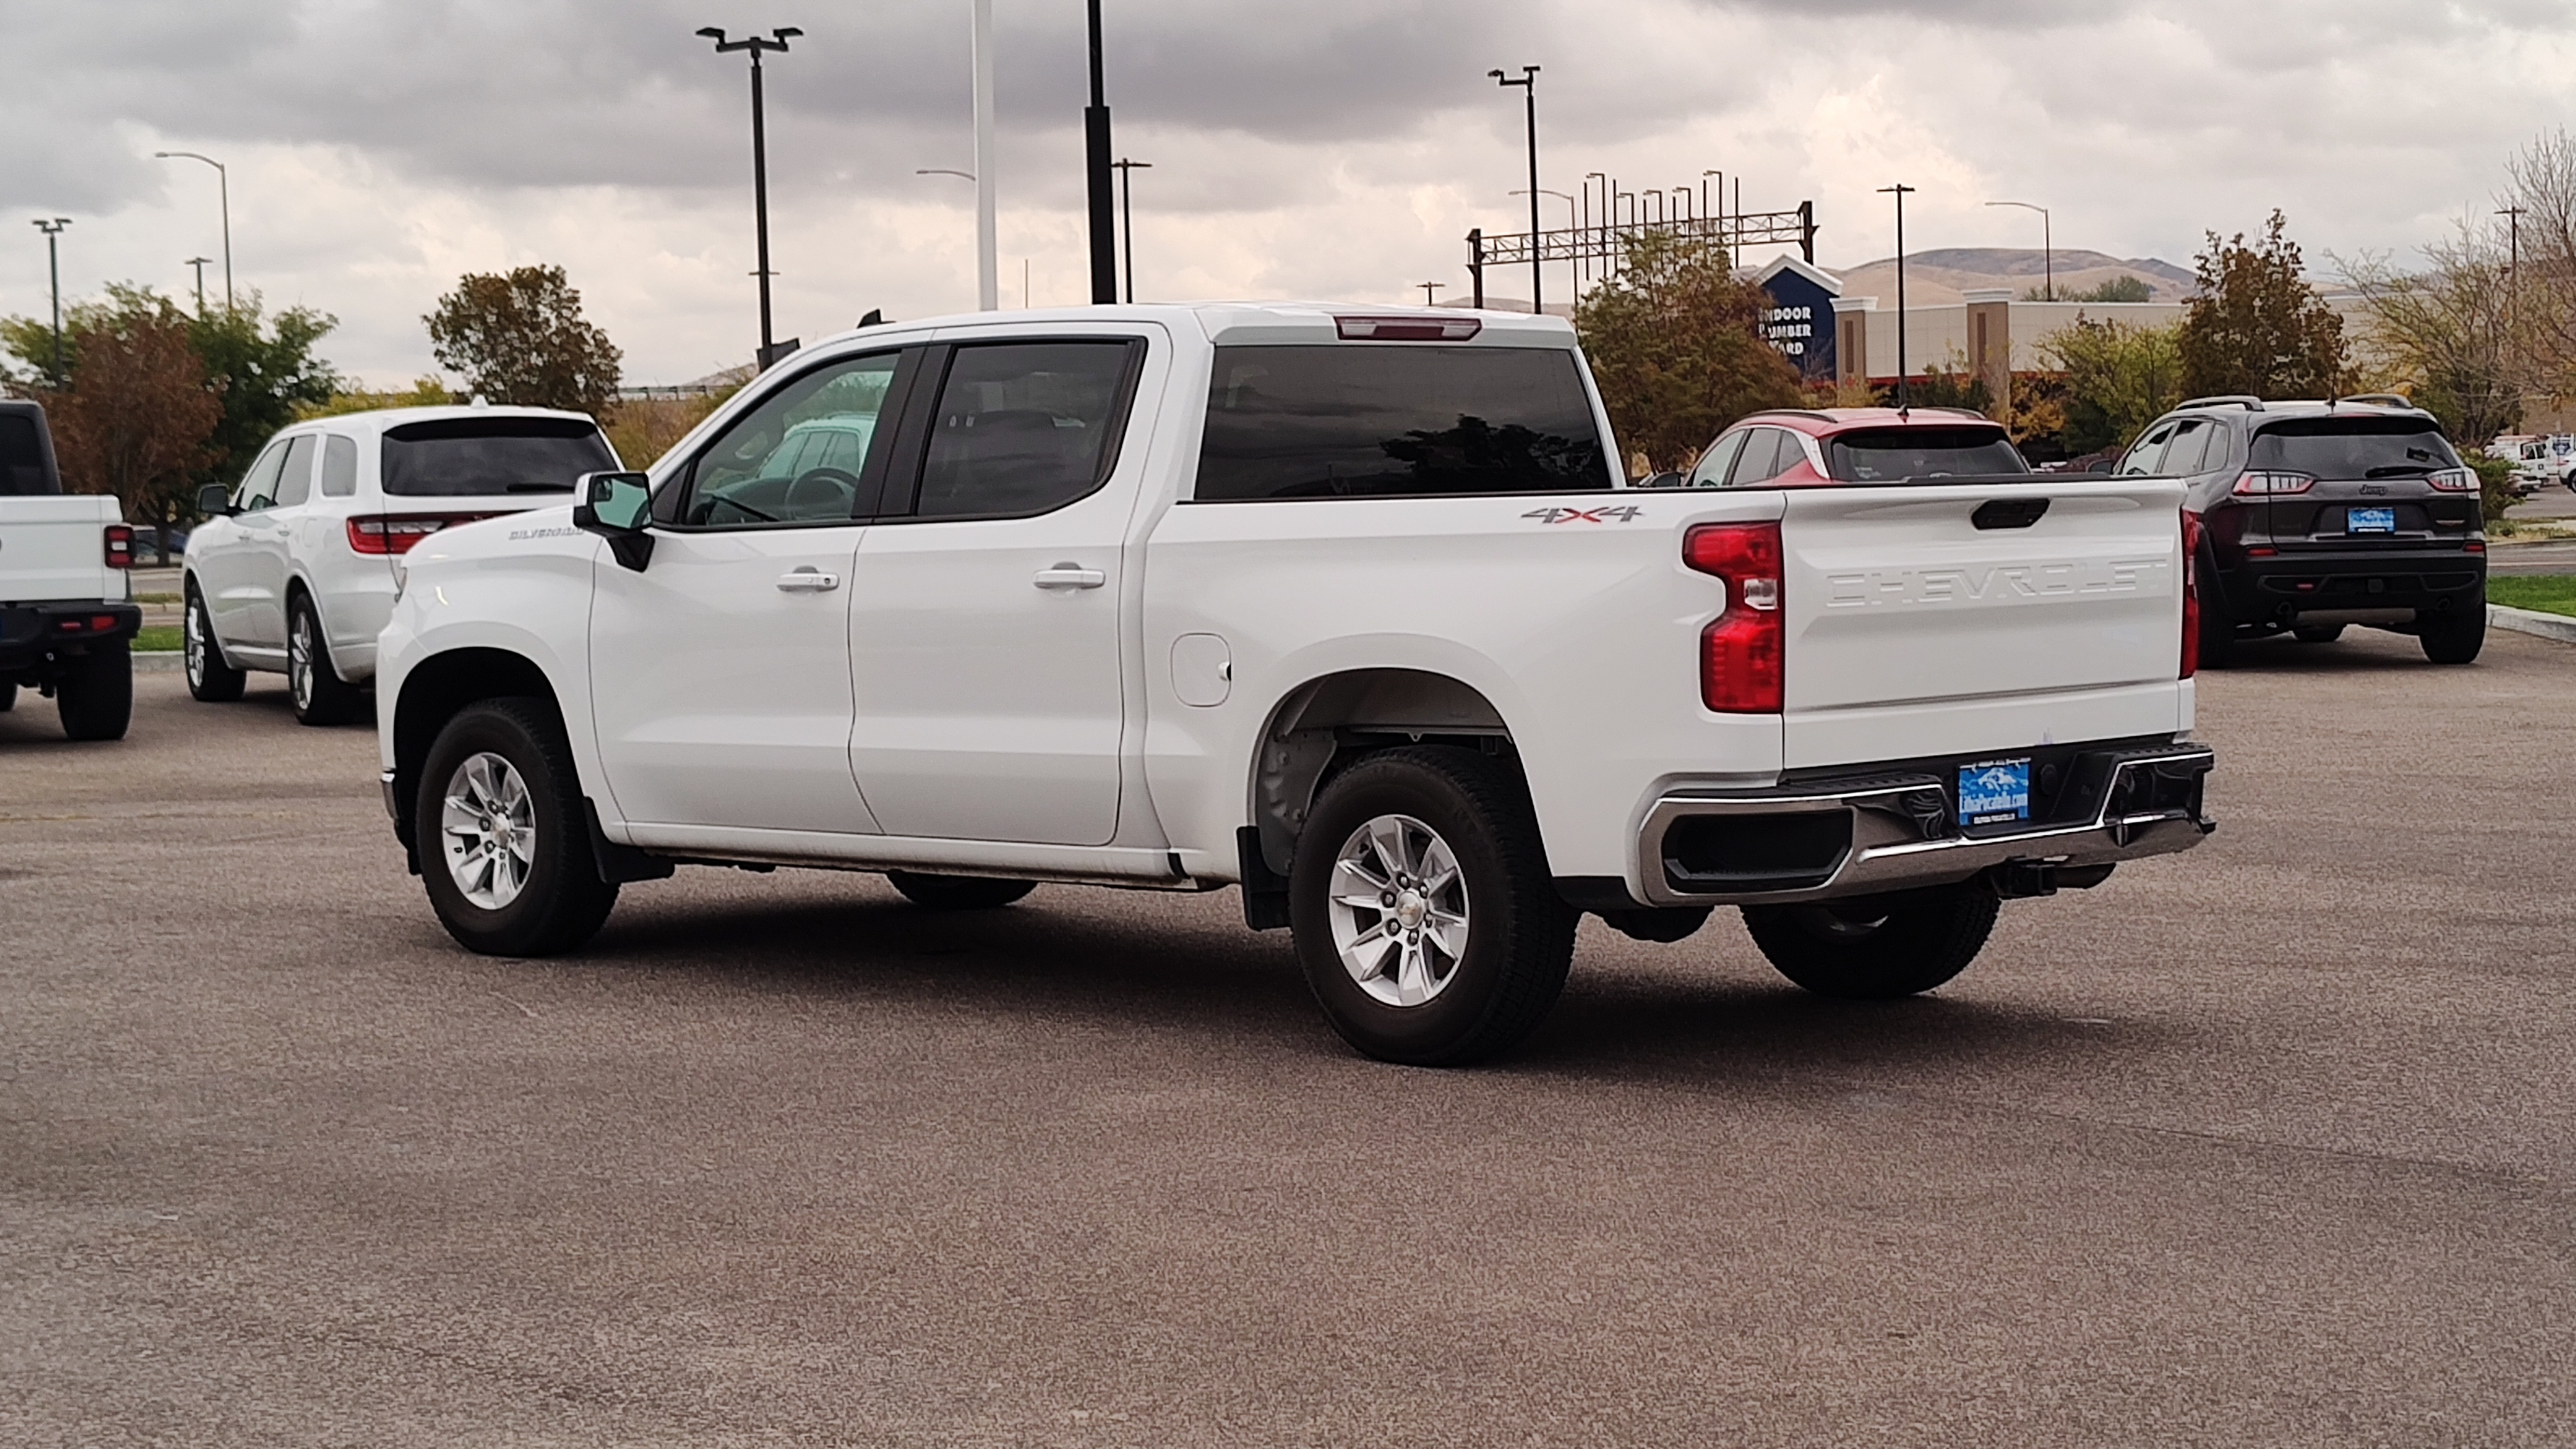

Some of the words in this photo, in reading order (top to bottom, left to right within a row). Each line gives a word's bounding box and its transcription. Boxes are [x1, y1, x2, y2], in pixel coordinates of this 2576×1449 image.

[1758, 306, 1811, 321] INDOOR
[2359, 484, 2388, 496] Jeep
[509, 527, 584, 540] SILVERADO
[1825, 557, 2168, 608] CHEVROLET
